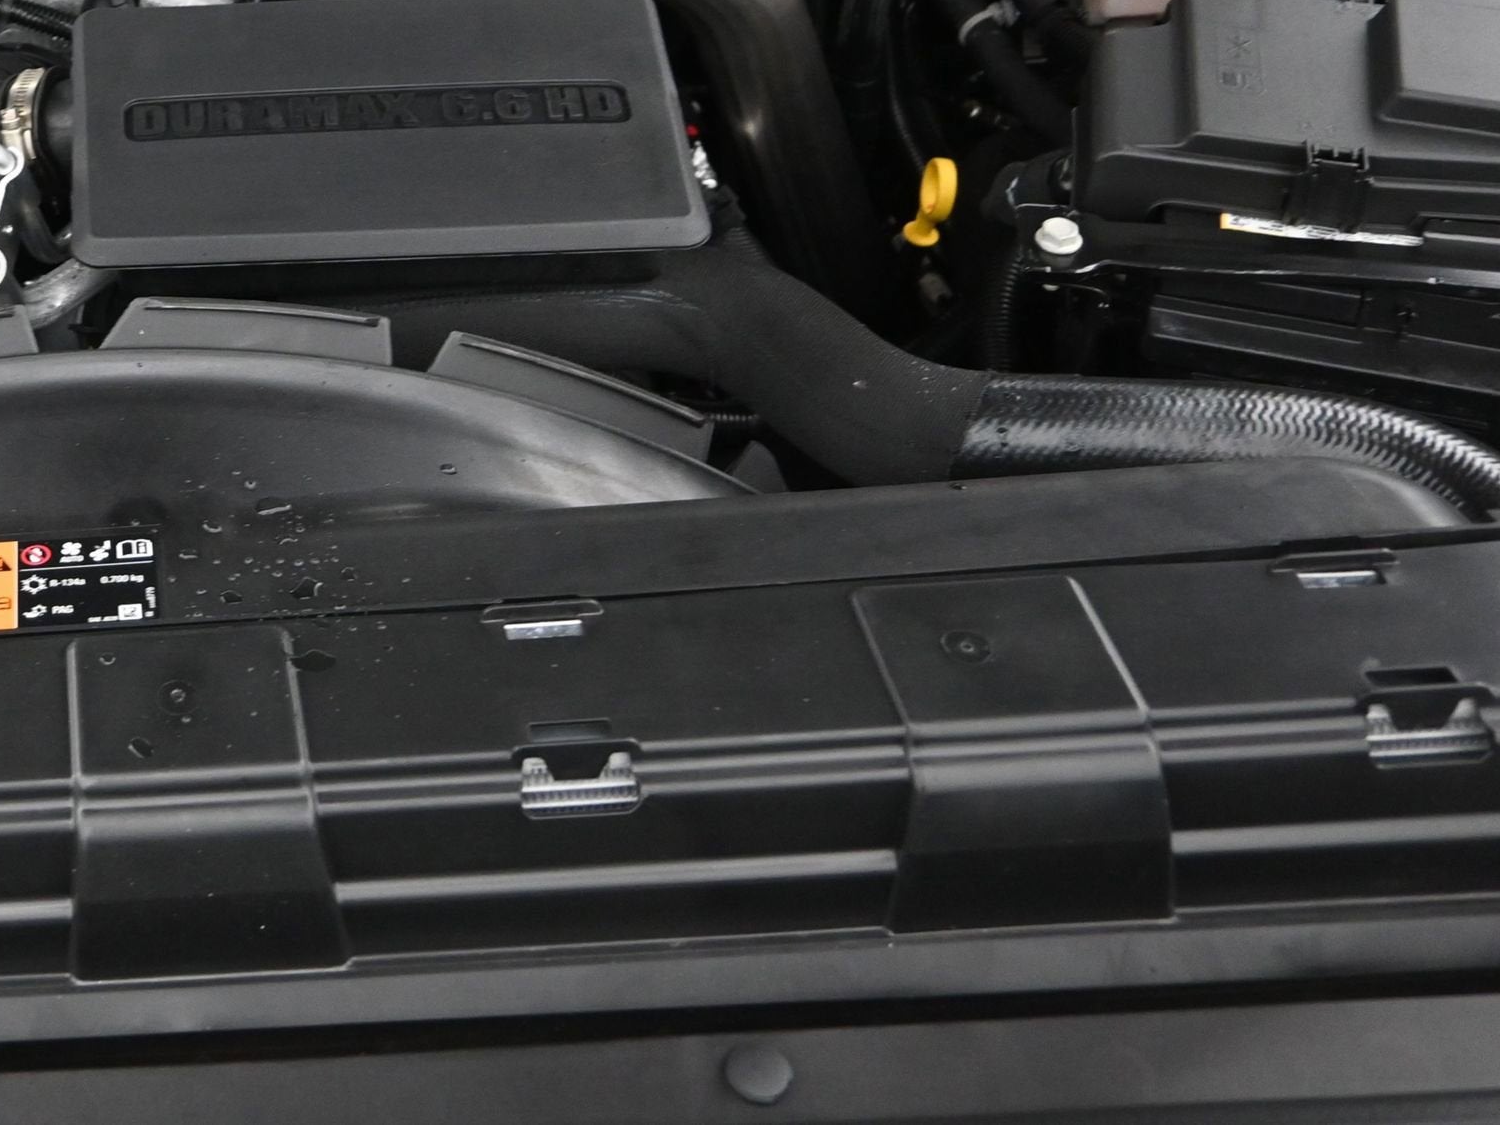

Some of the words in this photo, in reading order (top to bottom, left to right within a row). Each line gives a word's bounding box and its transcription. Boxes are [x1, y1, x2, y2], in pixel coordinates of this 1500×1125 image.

[137, 94, 418, 136] DURAMAX
[445, 88, 531, 123] 6.6
[544, 86, 624, 119] HD
